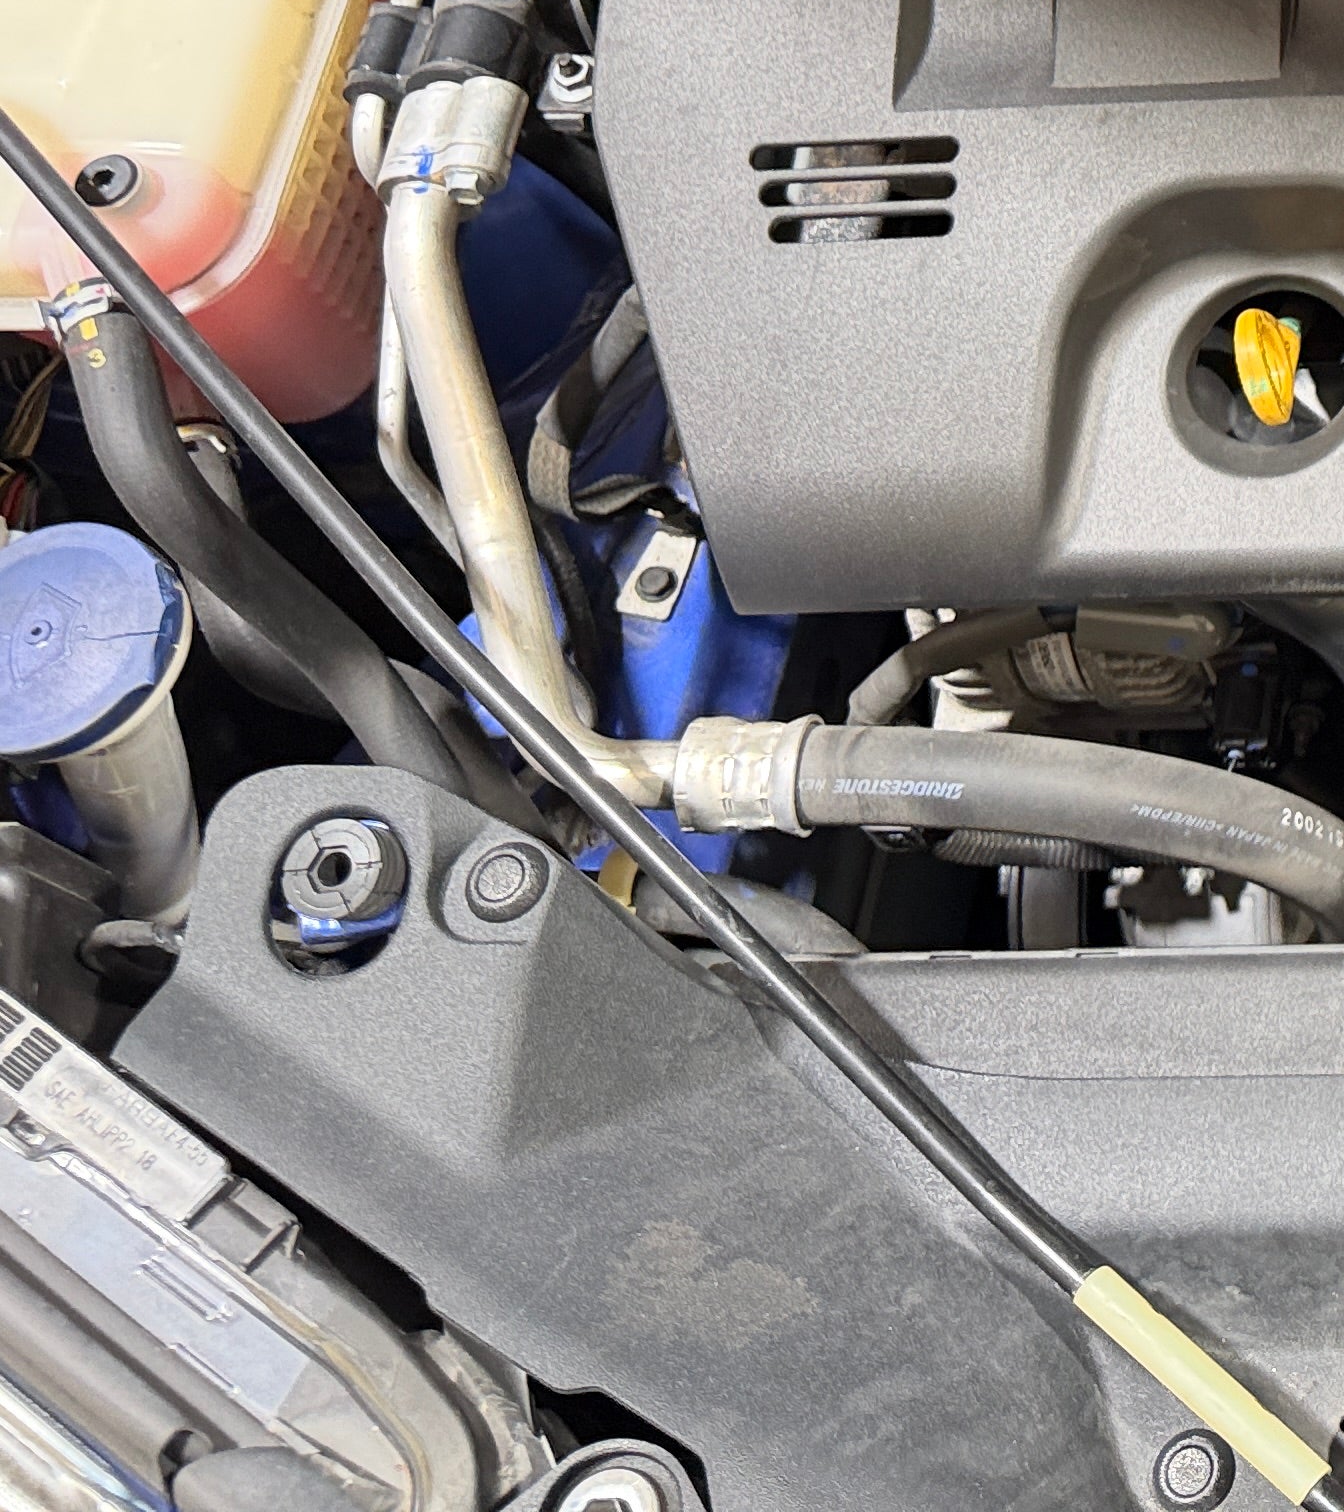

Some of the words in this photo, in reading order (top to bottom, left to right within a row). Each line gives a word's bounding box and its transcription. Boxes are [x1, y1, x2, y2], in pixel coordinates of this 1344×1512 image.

[87, 347, 107, 369] 3
[831, 776, 965, 800] BRIDGESTONE
[1225, 824, 1273, 849] JAPAN
[44, 1079, 76, 1109] SAE
